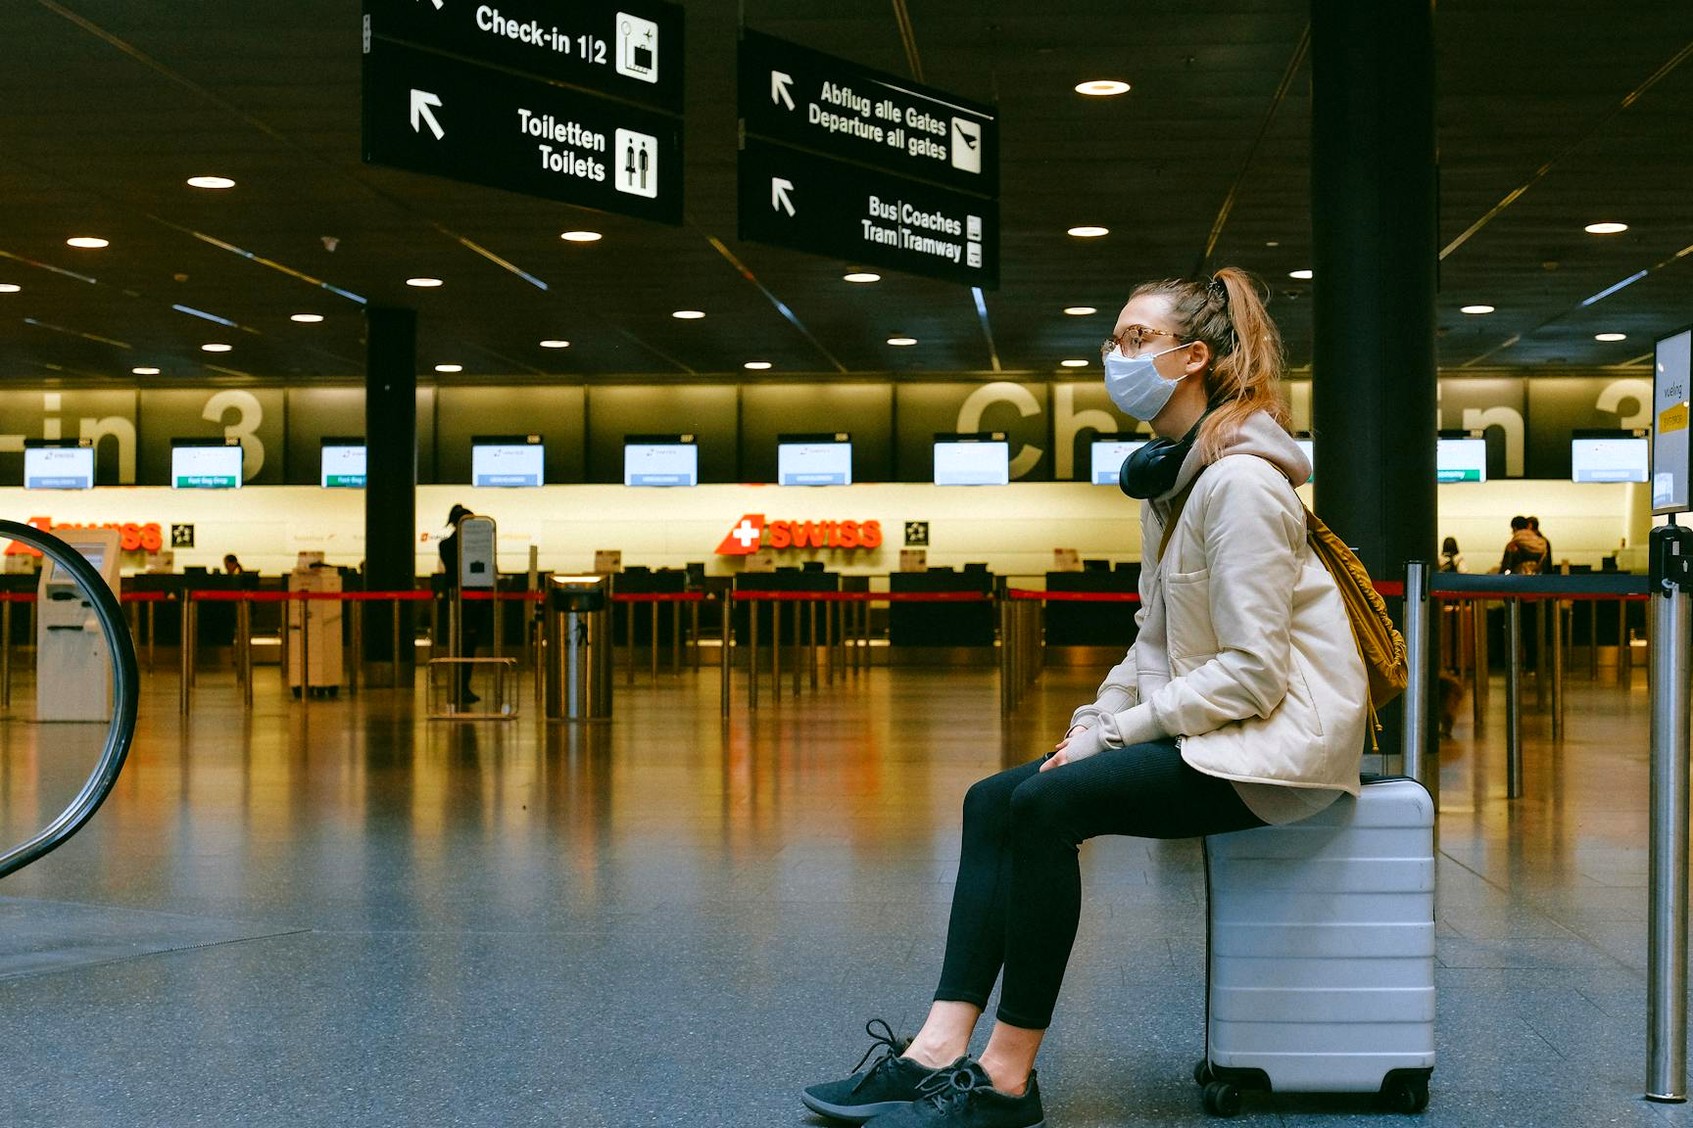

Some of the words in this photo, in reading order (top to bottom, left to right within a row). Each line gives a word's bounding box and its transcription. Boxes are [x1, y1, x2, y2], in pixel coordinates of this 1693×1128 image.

[475, 4, 571, 55] Check-in
[517, 107, 606, 153] Toiletten
[808, 102, 884, 143] Departure
[886, 128, 905, 149] all
[907, 137, 947, 161] gates
[820, 80, 872, 118] Abflug
[874, 99, 902, 124] alle
[905, 106, 947, 137] Gates
[538, 143, 606, 182] Toilets
[767, 519, 884, 548] SWISS
